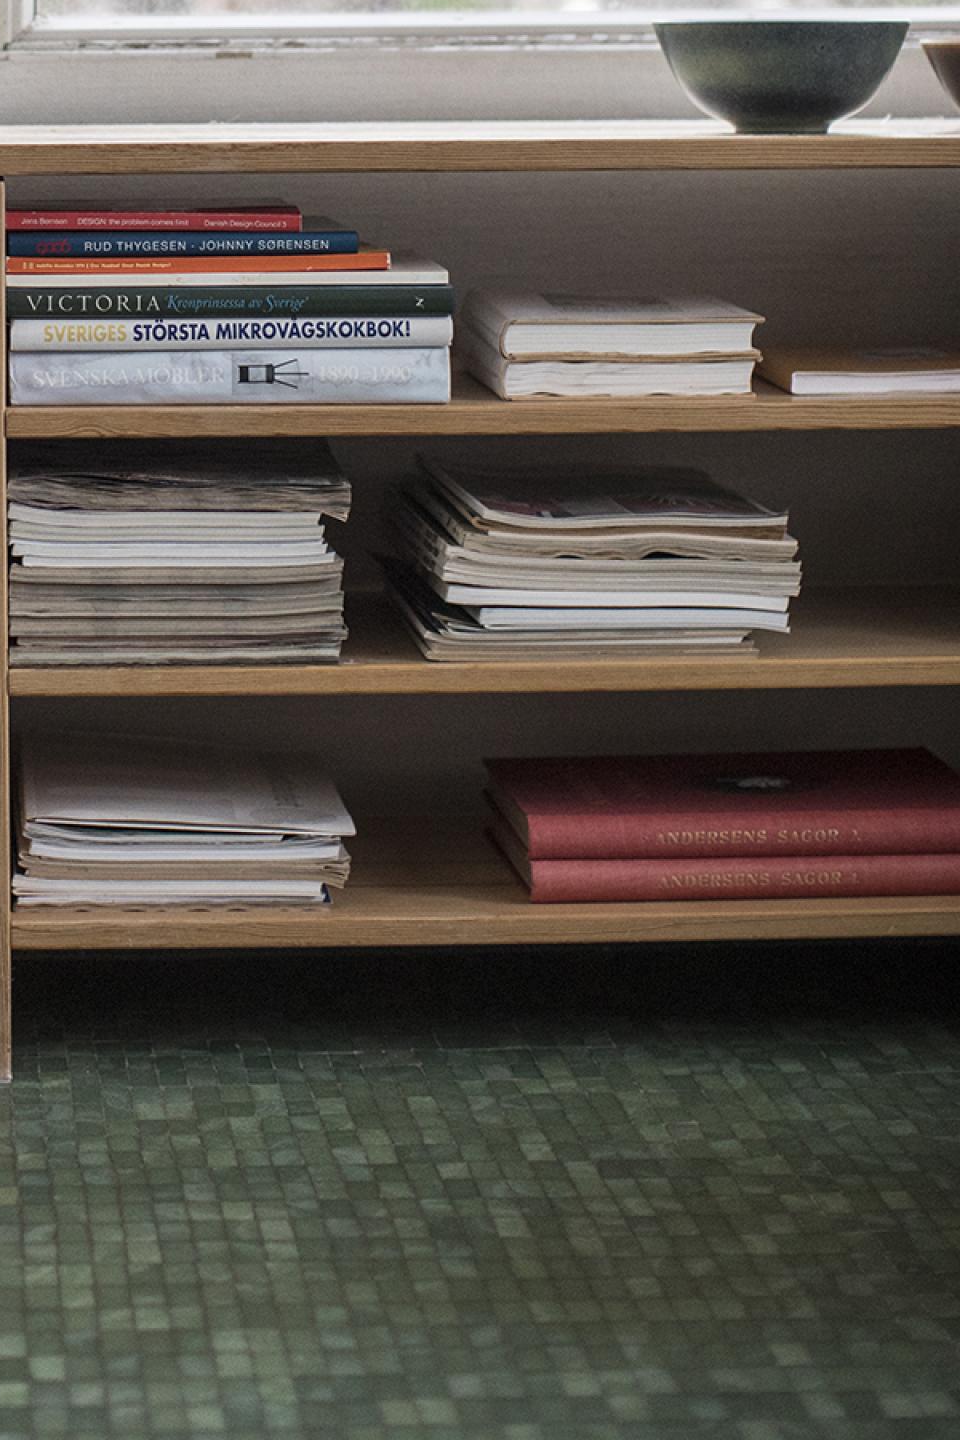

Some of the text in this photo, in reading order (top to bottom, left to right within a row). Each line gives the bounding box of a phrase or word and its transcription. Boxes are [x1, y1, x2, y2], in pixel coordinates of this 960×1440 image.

[84, 241, 113, 252] RUD
[116, 240, 187, 252] THYGESEN
[199, 240, 253, 251] JOHNNY
[258, 239, 330, 250] SØRENSEN
[26, 295, 161, 312] VICTORIA
[43, 315, 411, 343] SVERIGES STÖRSTA MIKROVÅGSKOKBOK!
[33, 368, 129, 389] SVENSKA
[133, 362, 225, 386] MÖBLER
[656, 829, 768, 845] ANDERSENS
[778, 829, 839, 844] SAGOR
[657, 871, 771, 889] ANDERSENS
[781, 871, 842, 886] SAGOR
